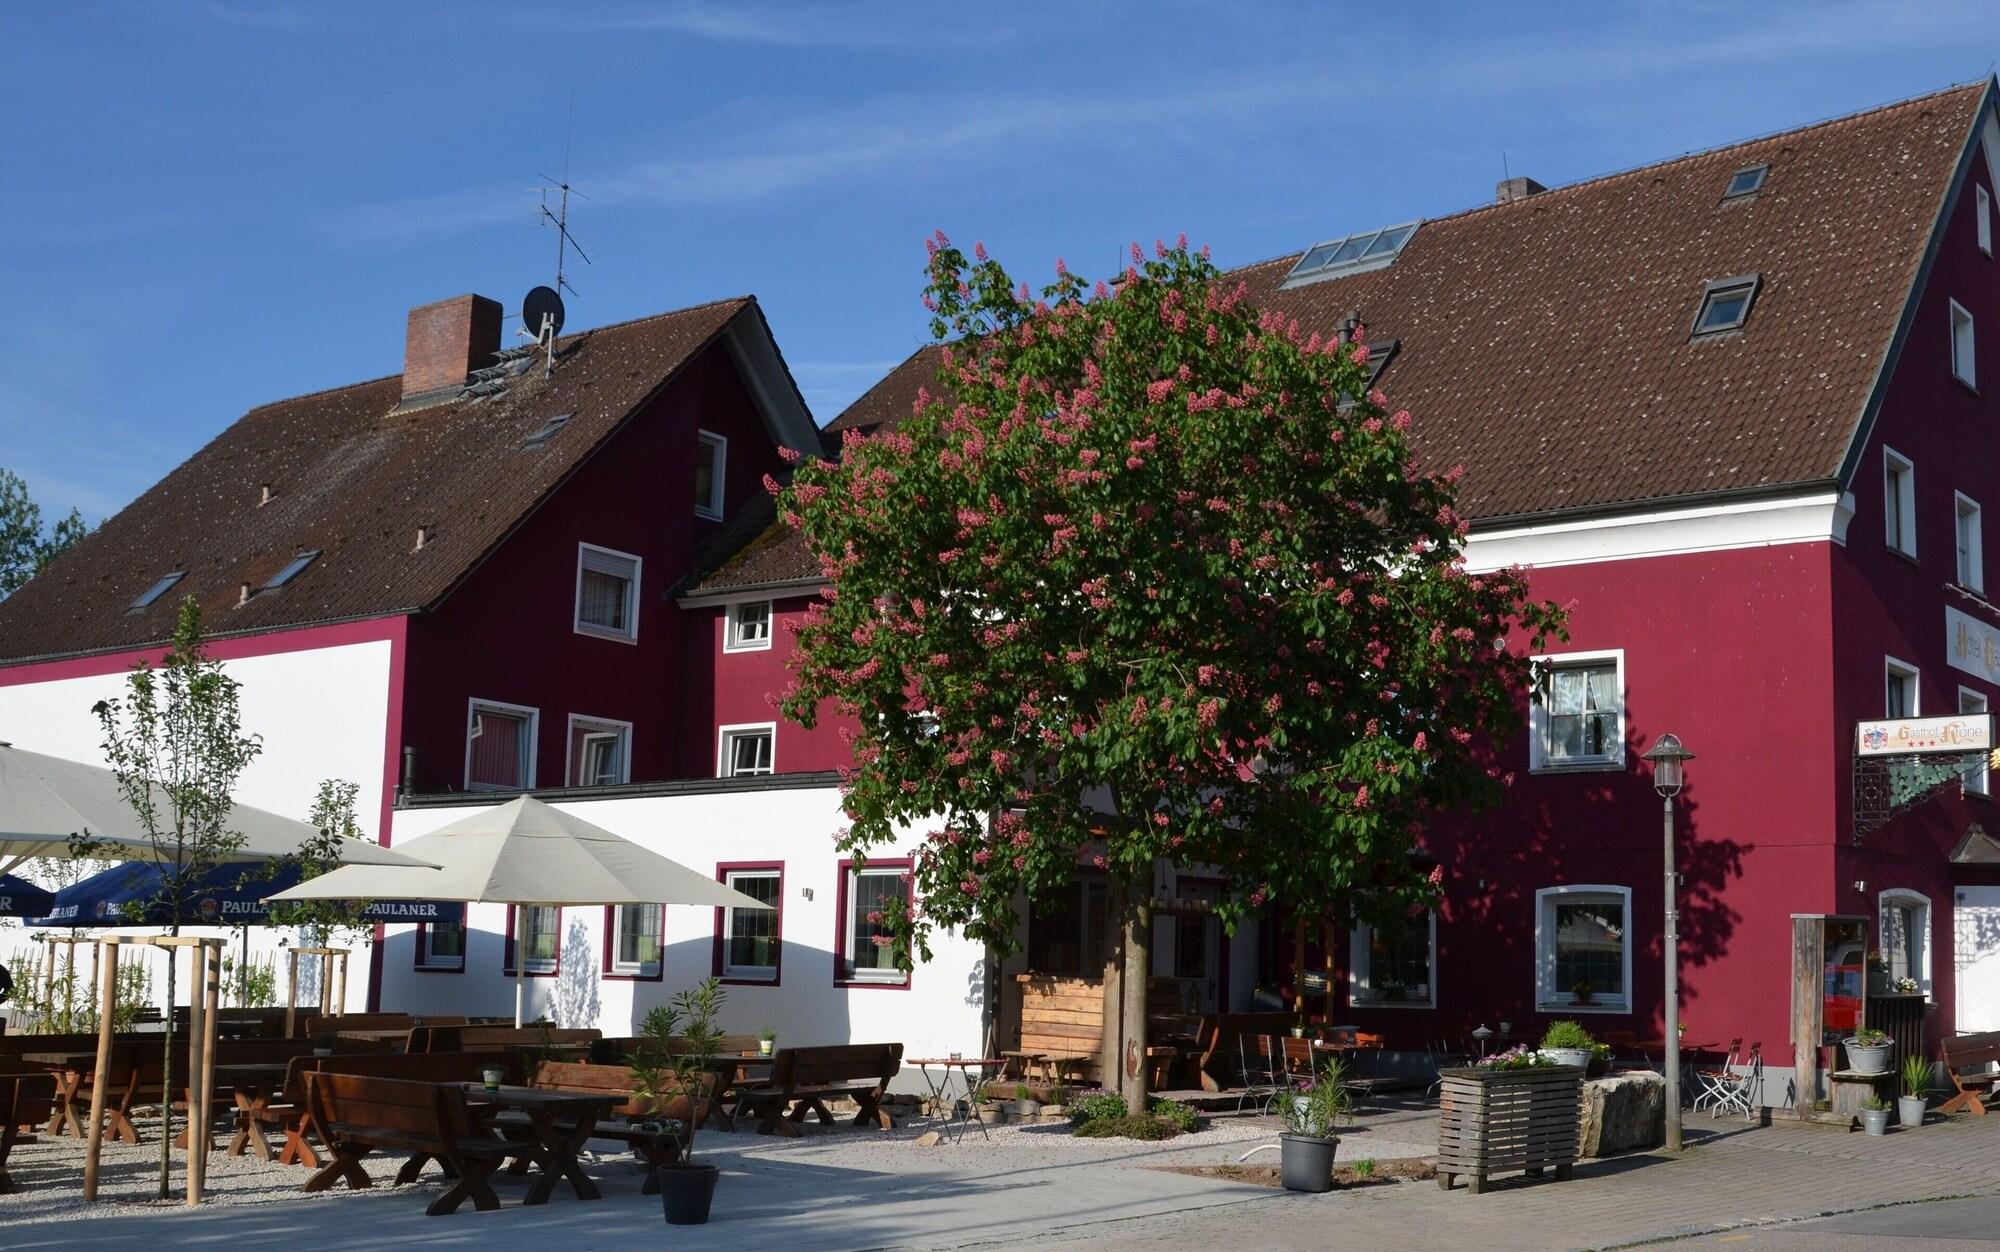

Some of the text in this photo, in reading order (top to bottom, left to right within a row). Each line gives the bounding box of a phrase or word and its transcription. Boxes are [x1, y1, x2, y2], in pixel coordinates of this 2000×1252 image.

[1898, 720, 1983, 745] Gasthof Krone
[364, 903, 438, 916] PAULANER
